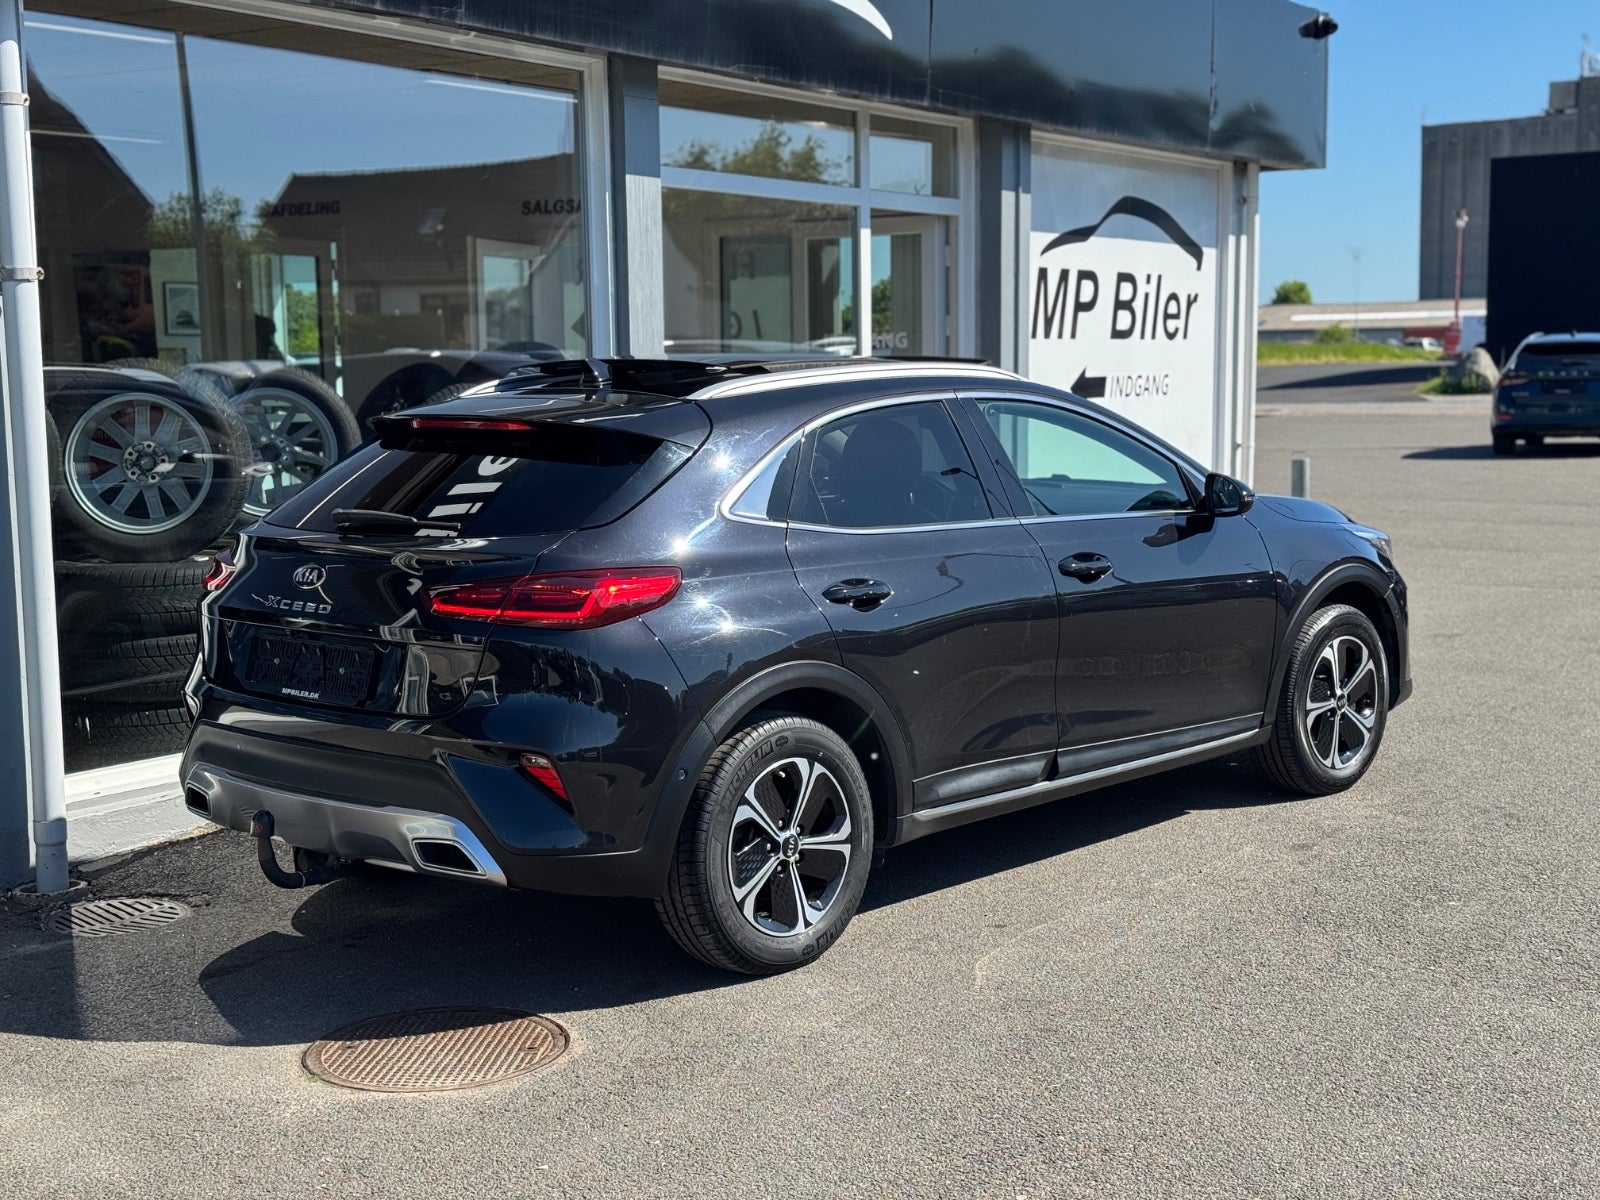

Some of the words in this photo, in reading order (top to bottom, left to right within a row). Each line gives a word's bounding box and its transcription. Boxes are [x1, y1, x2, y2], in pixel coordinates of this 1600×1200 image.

[1031, 267, 1099, 339] MP
[1110, 272, 1199, 340] Biler
[1110, 374, 1169, 398] INDGANG
[295, 568, 319, 583] KIA
[265, 595, 332, 614] XCEED
